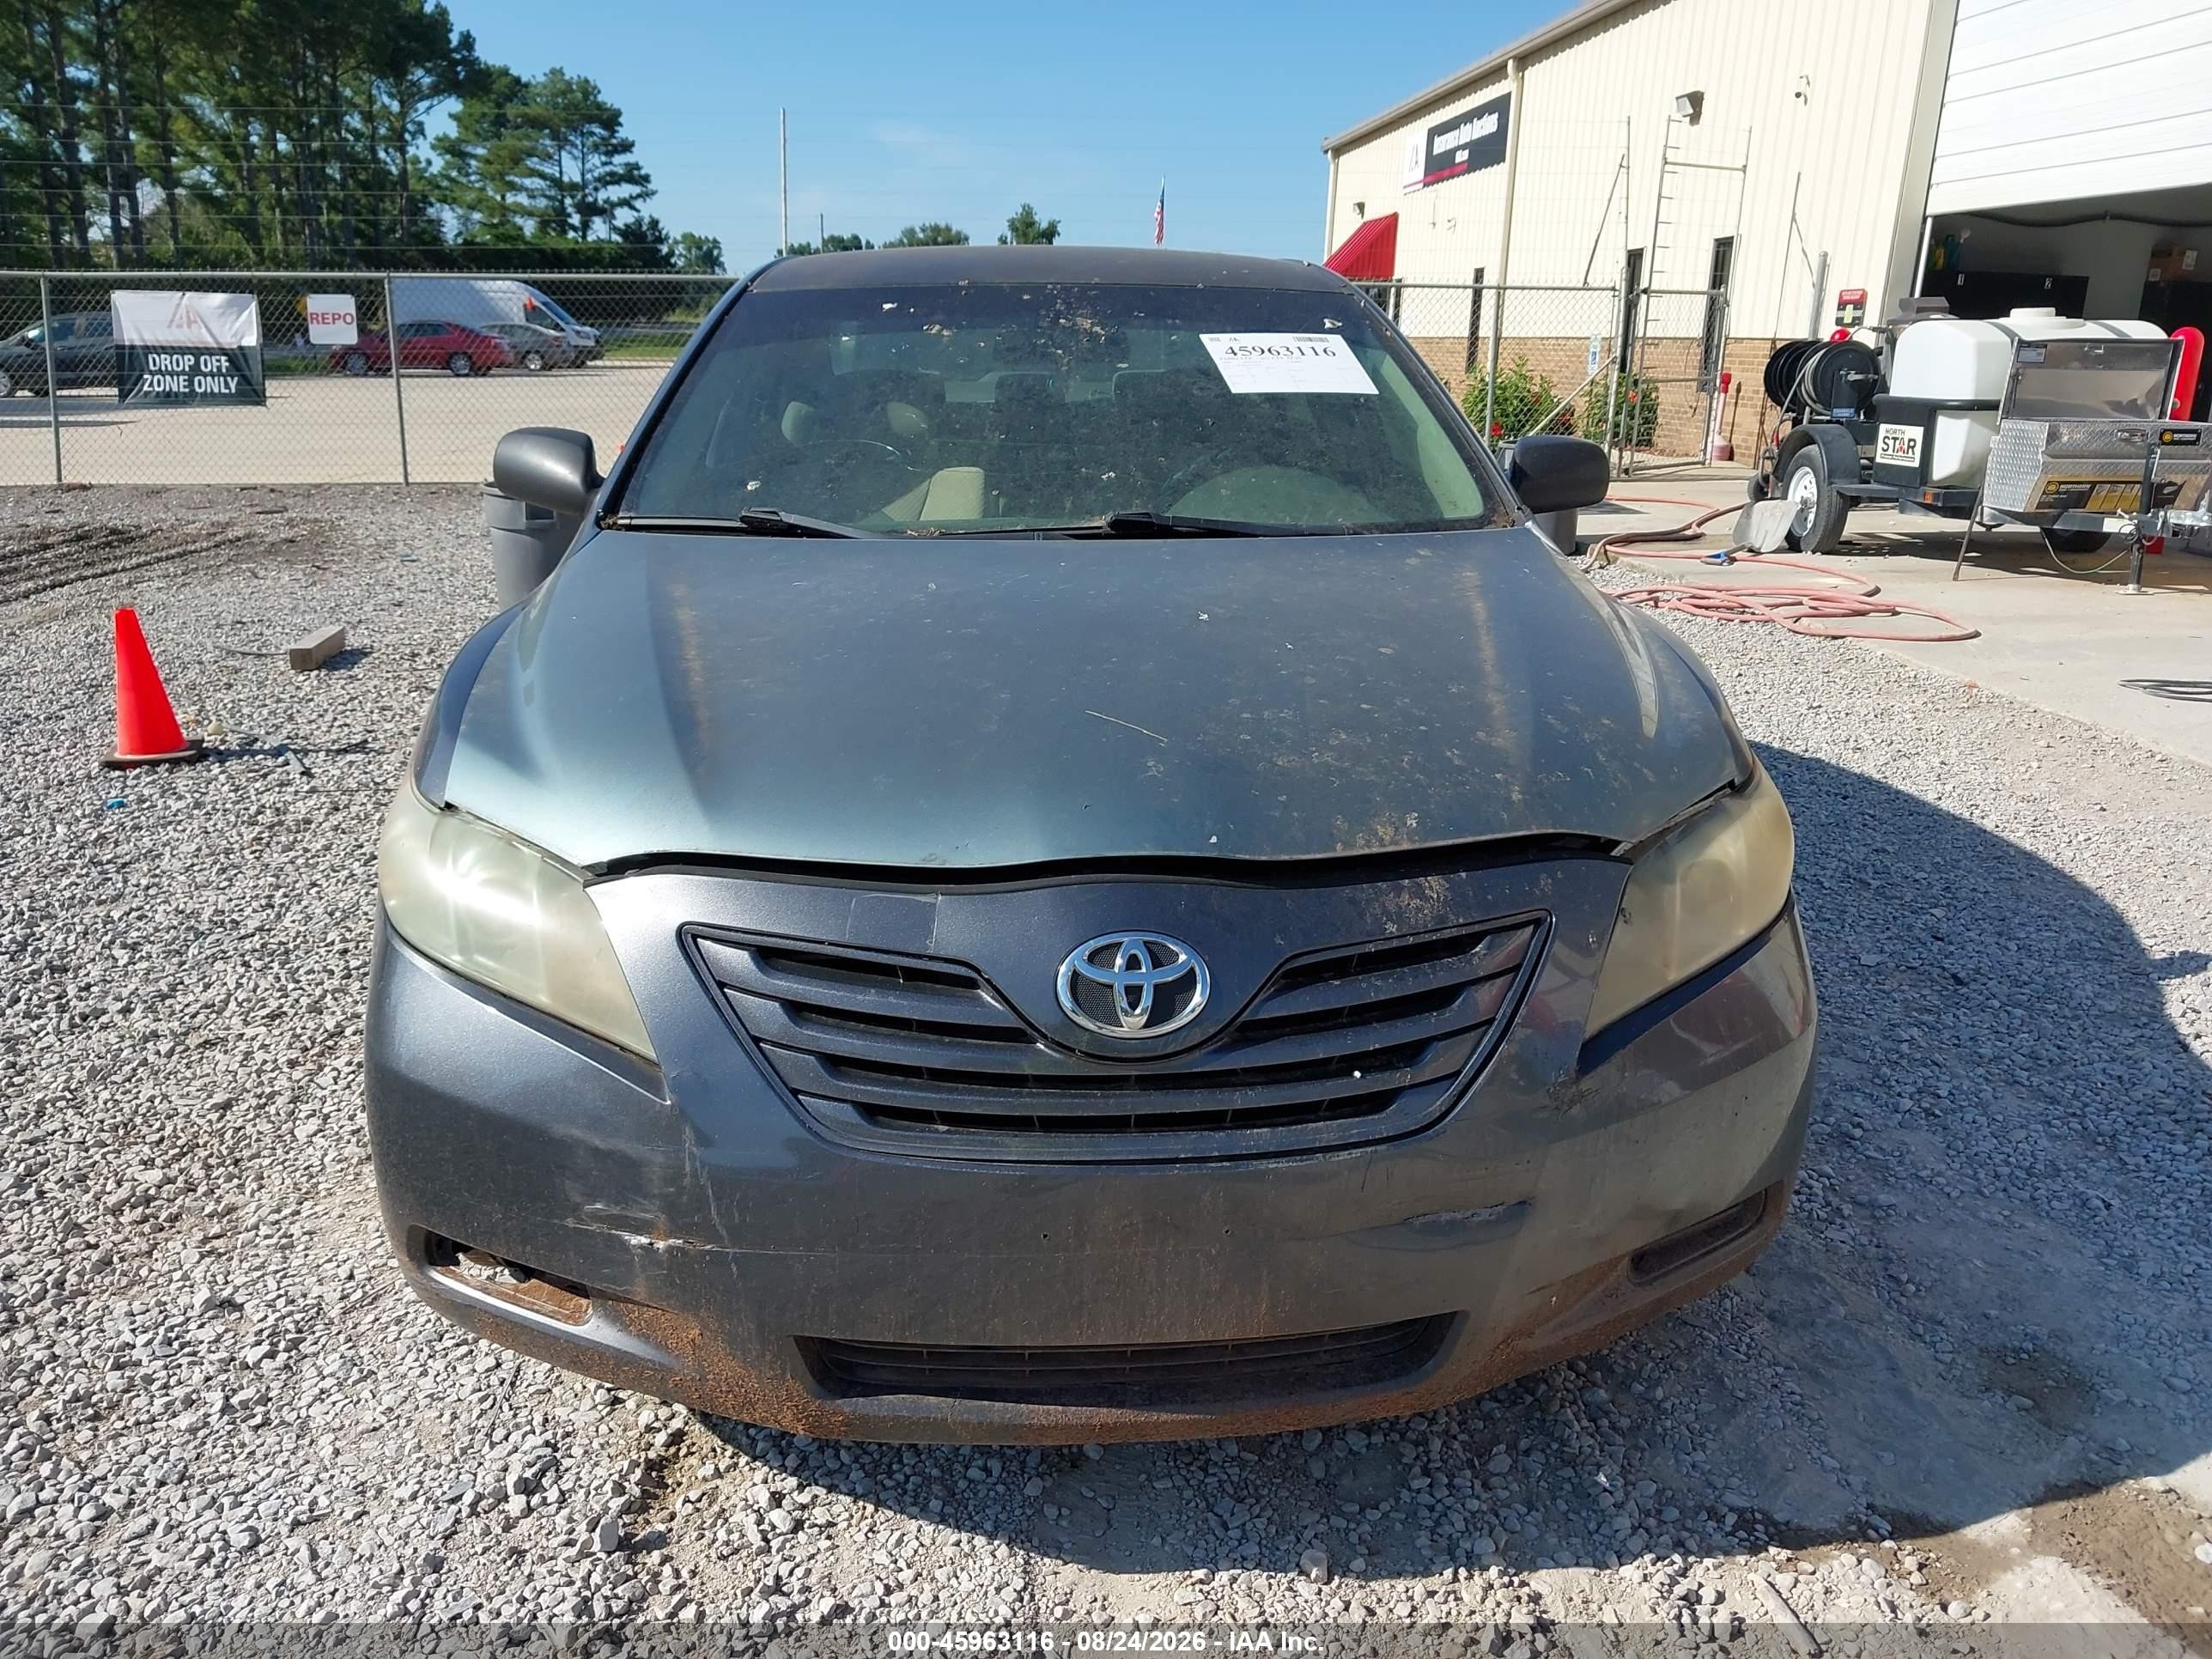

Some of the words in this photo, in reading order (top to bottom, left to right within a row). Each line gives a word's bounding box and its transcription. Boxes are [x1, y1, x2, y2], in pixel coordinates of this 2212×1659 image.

[309, 312, 355, 325] REPO
[1224, 345, 1337, 358] 45963116
[148, 353, 195, 372] DROP
[199, 355, 230, 373] OFF
[143, 374, 190, 392] ZONE
[194, 375, 239, 394] ONLY
[1885, 428, 1905, 436] NORTH
[1881, 435, 1917, 455] STAR
